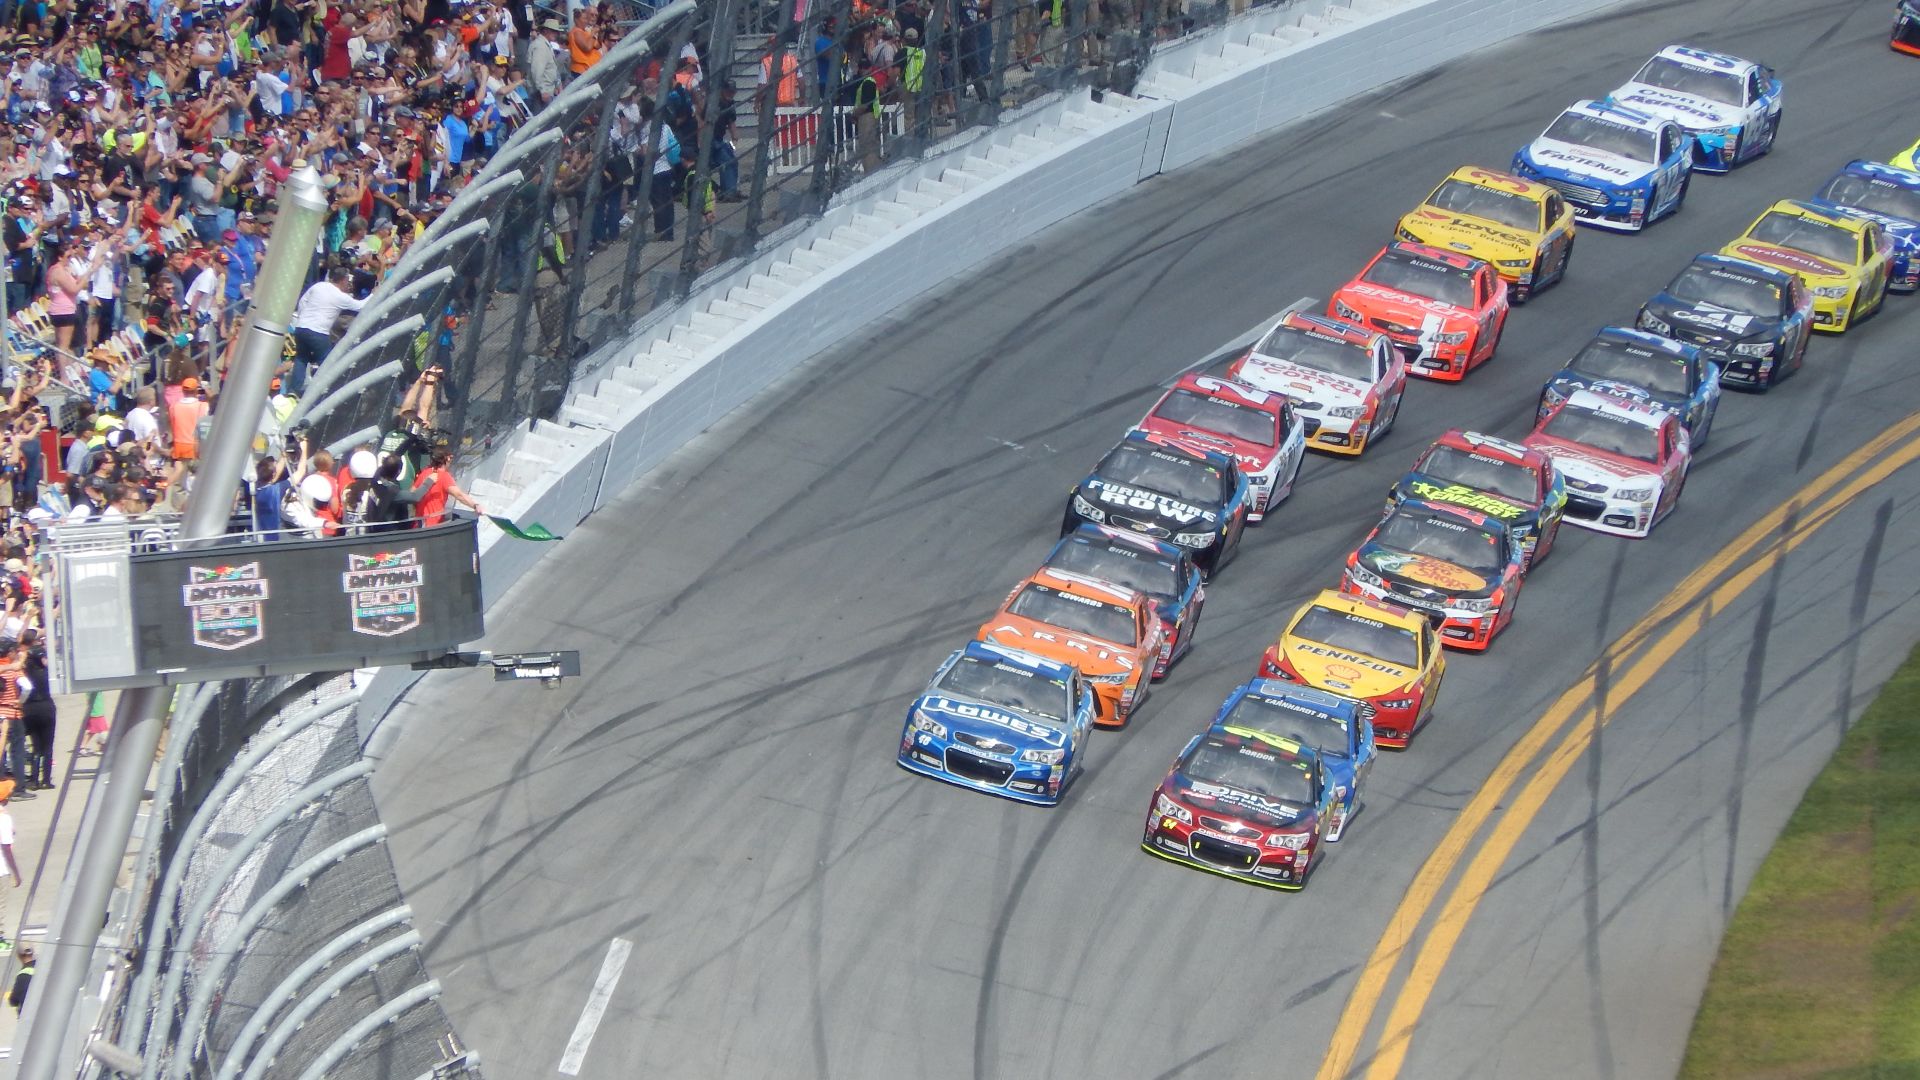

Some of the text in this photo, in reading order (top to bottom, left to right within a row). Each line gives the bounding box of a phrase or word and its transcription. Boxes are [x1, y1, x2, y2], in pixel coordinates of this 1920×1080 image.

[1538, 149, 1630, 177] FASTENAL
[1871, 179, 1898, 189] WHITT
[1410, 260, 1447, 273] ALLGAIER
[1710, 270, 1758, 285] McMURRAY
[1673, 310, 1744, 335] Cessna
[1304, 331, 1347, 345] SORENSON
[1626, 347, 1653, 358] KAHNE
[1208, 396, 1240, 409] BLANEY
[1593, 410, 1630, 425] HARVICK
[1469, 453, 1505, 466] BOWYER
[1088, 480, 1217, 523] FURNITURE
[1100, 490, 1197, 523] ROW
[1426, 518, 1468, 534] STEWART
[1108, 546, 1138, 559] BIFFLE
[349, 568, 419, 589] DAYTONA
[190, 584, 262, 600] DAYTONA
[358, 590, 411, 608] 500
[1058, 591, 1103, 608] EDWARDS
[199, 602, 256, 621] 500
[1346, 614, 1384, 629] LOGANO
[995, 625, 1133, 670] ARRIS
[1296, 643, 1404, 678] PENNZOIL
[994, 663, 1033, 678] JOHNSON
[1264, 698, 1316, 717] EARNHARDT
[938, 698, 1050, 738] LOWE'S
[953, 743, 1000, 760] CHEVROLET
[1239, 748, 1276, 762] GORDON
[1191, 780, 1299, 816] DRIVE
[1162, 818, 1177, 830] 24
[1198, 828, 1245, 844] CHEVROLET
